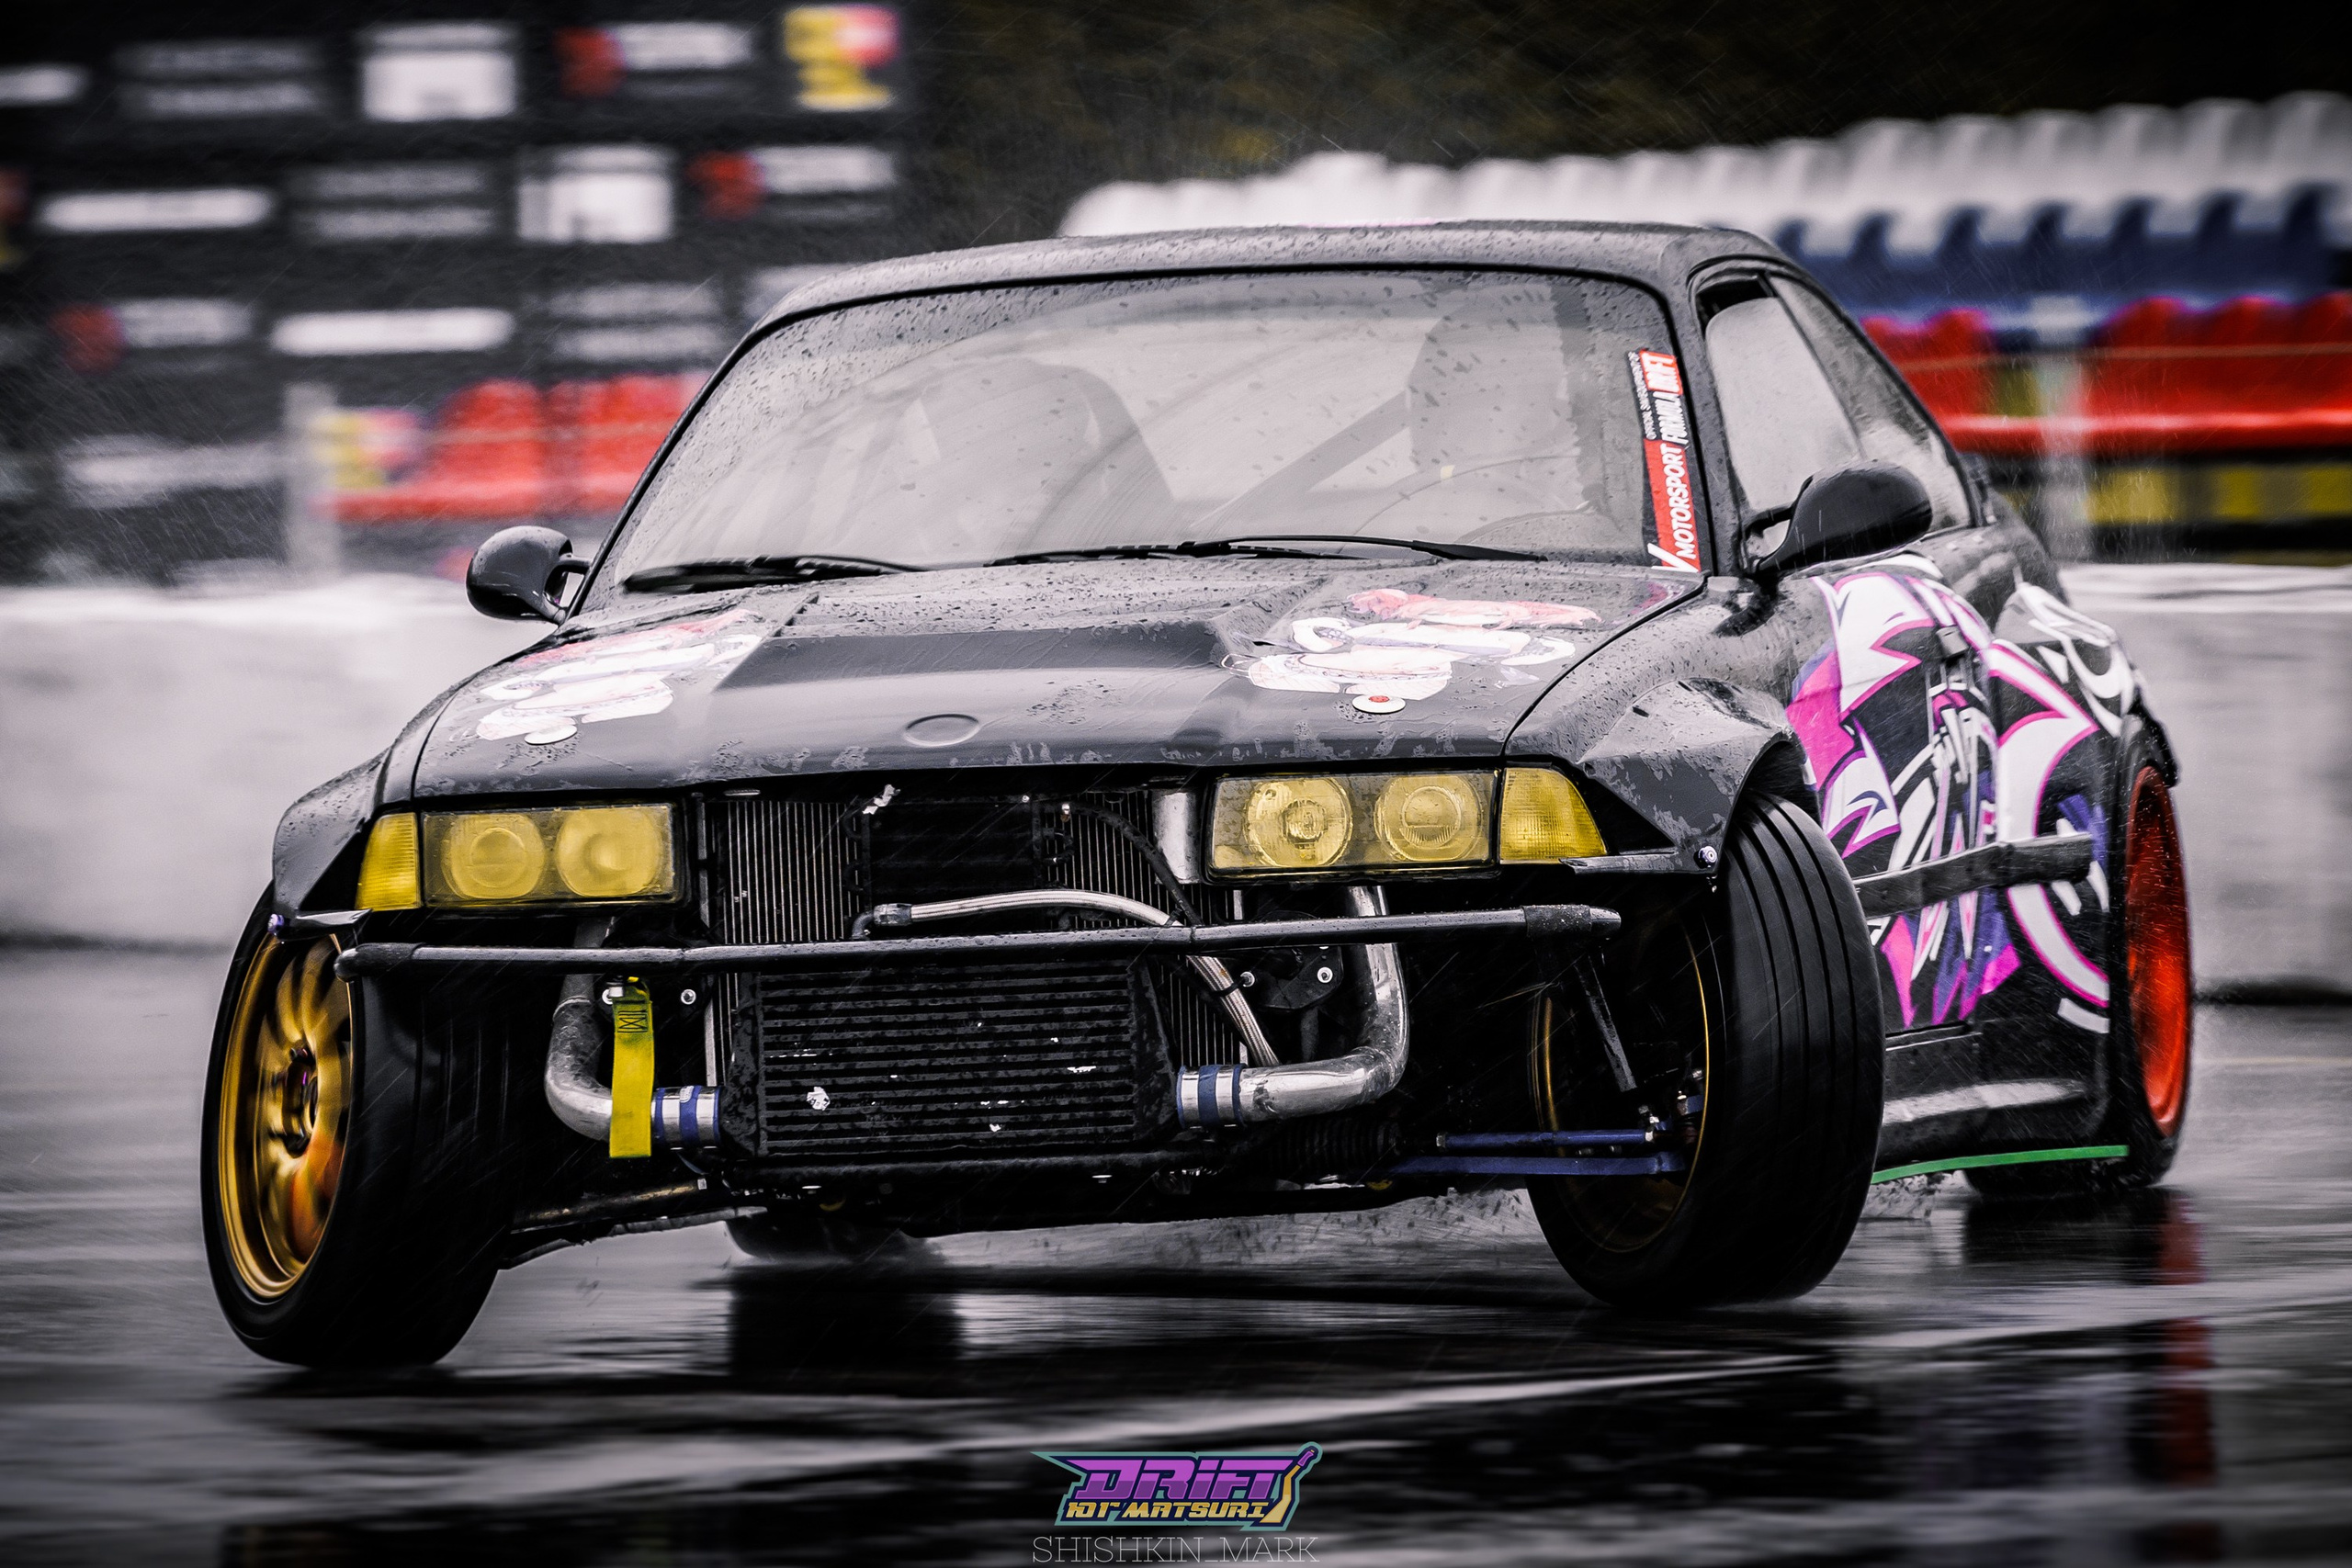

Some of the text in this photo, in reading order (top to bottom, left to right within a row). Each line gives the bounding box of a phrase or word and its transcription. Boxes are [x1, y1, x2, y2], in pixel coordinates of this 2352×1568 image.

[1642, 353, 1689, 445] FORMULA DRIFT
[1660, 443, 1696, 559] MOTORSPORT
